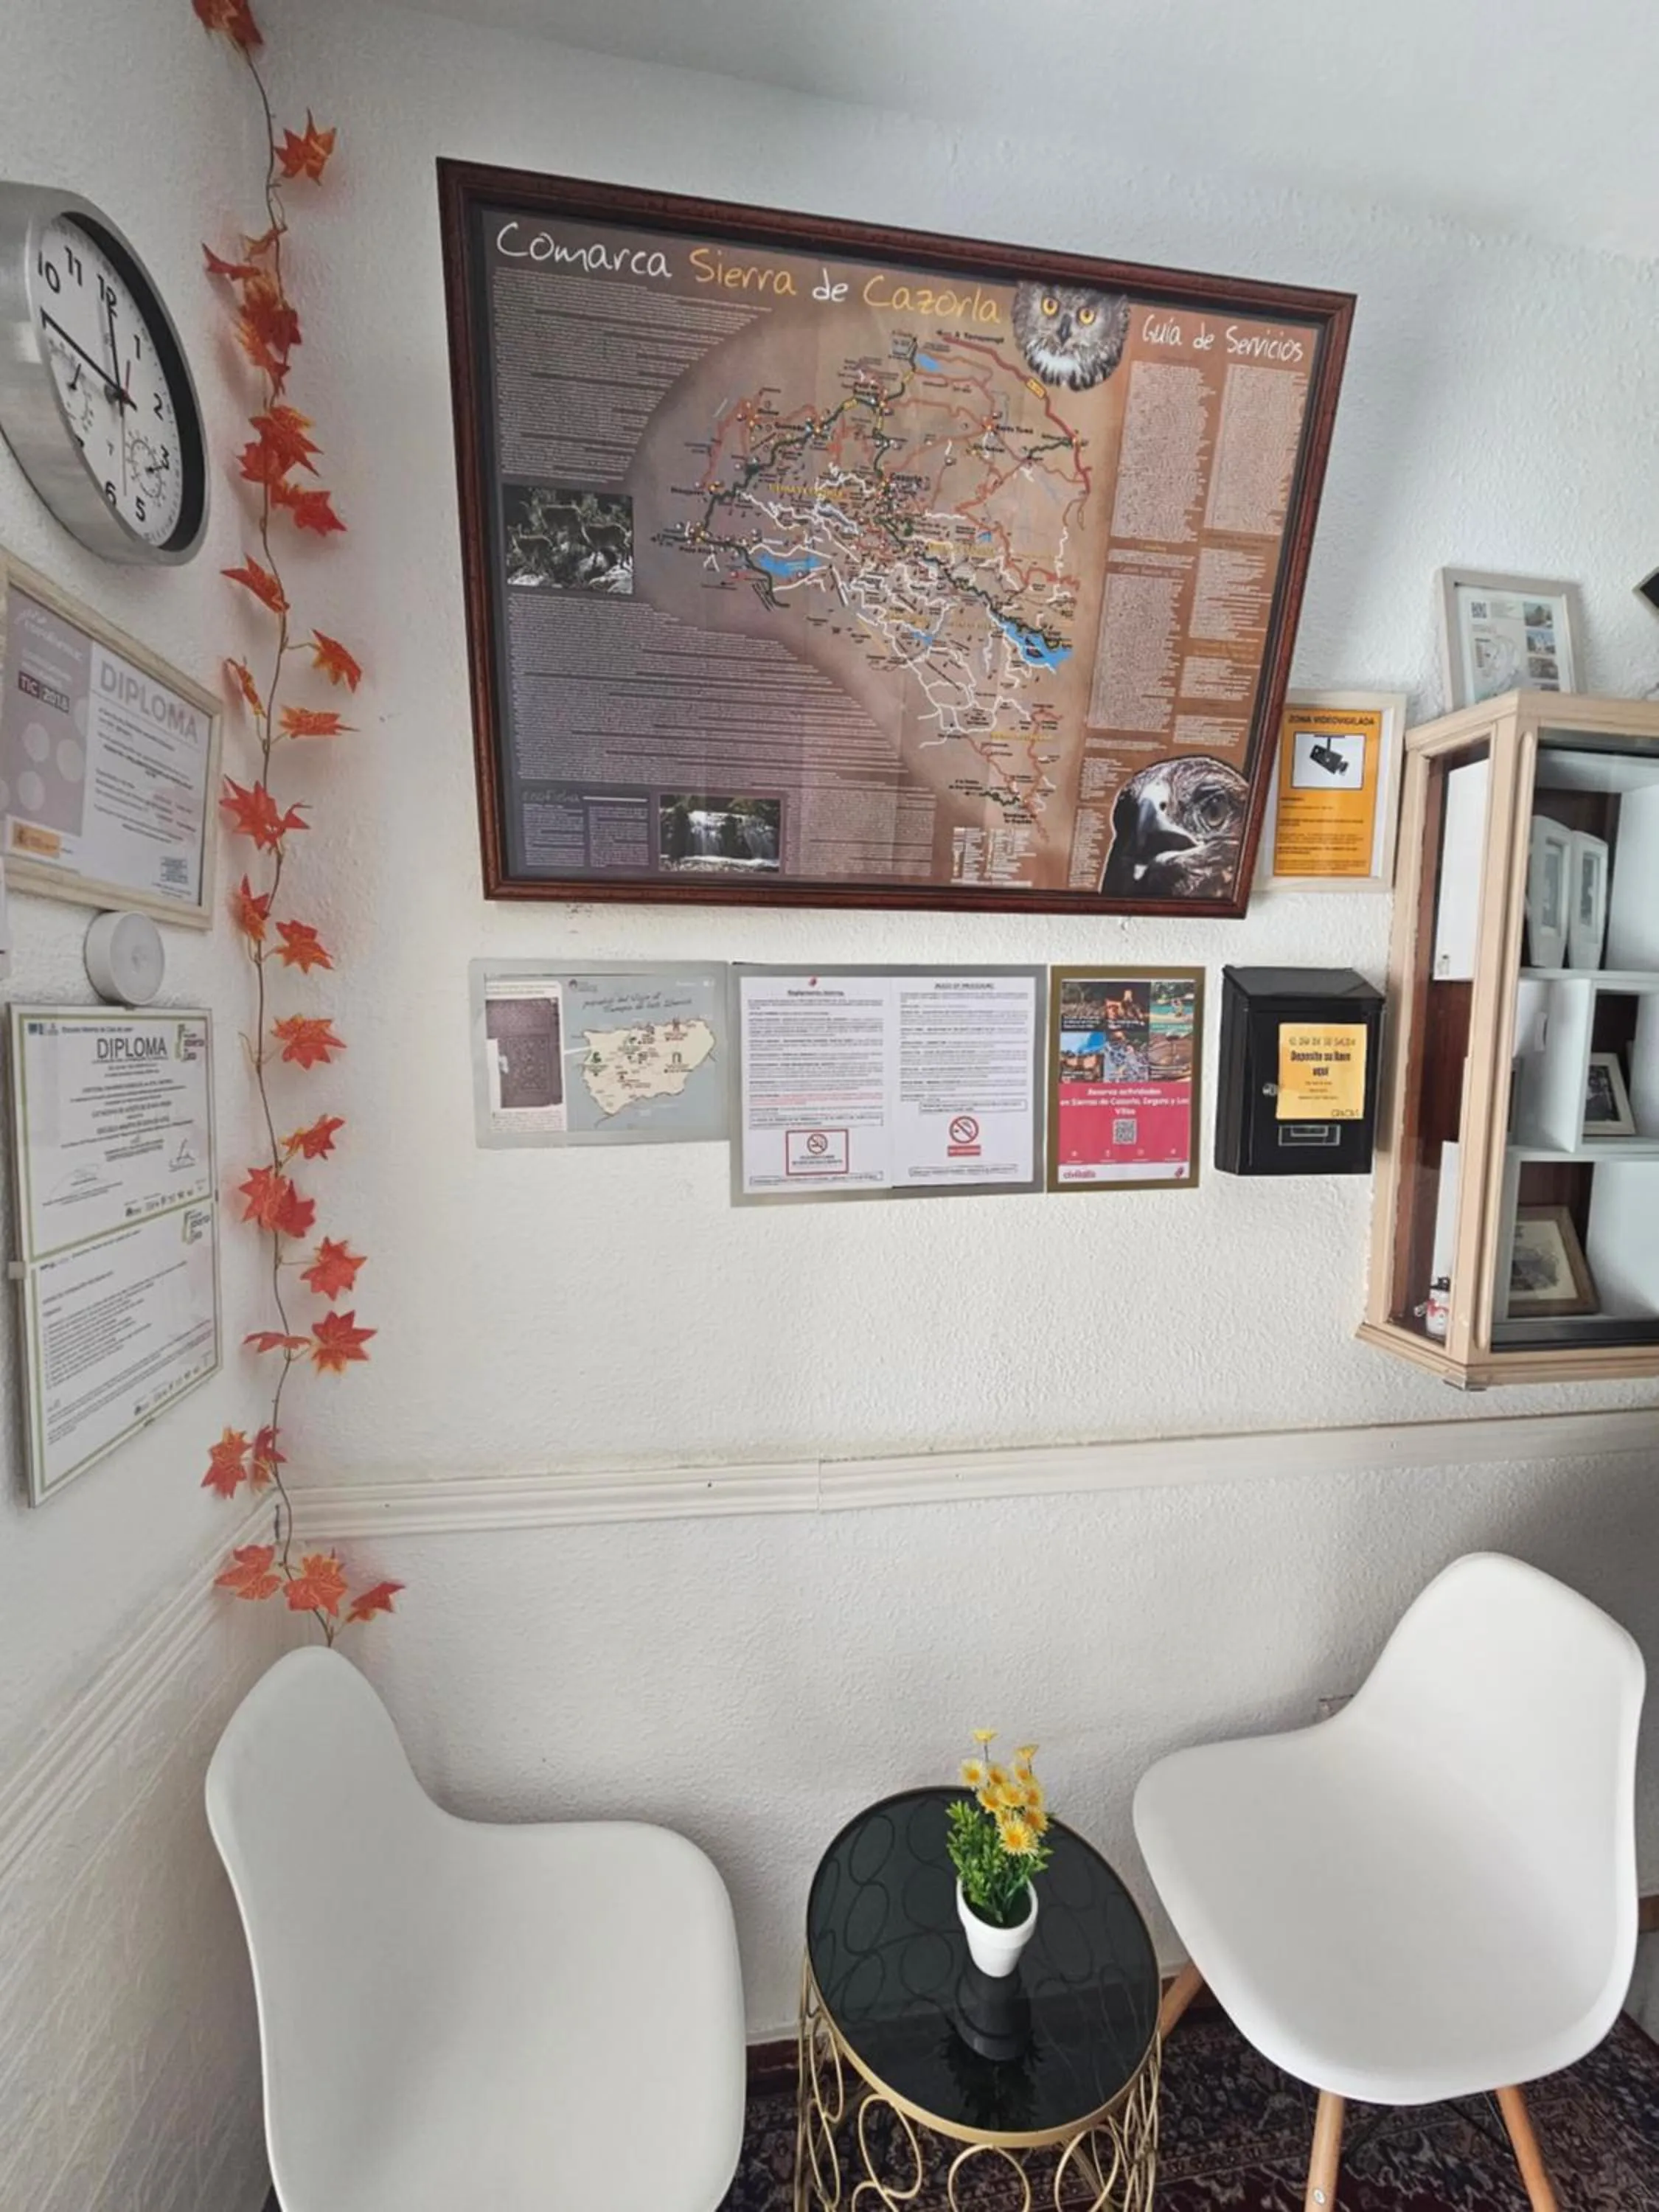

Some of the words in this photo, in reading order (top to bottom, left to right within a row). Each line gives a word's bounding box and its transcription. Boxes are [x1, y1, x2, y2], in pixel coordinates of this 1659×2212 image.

[38, 249, 60, 294] 10
[63, 244, 83, 288] 11
[496, 221, 672, 279] Comarca
[689, 247, 797, 296] Sierra
[812, 267, 849, 302] de
[862, 274, 1001, 324] Cazorla
[133, 333, 141, 361] 1
[1142, 313, 1183, 347] Guía
[1192, 321, 1215, 352] de
[1225, 324, 1304, 364] Servicios
[153, 392, 164, 422] 2
[135, 495, 146, 522] 5
[100, 659, 198, 744] DIPLOMA
[97, 1037, 168, 1060] DIPLOMA
